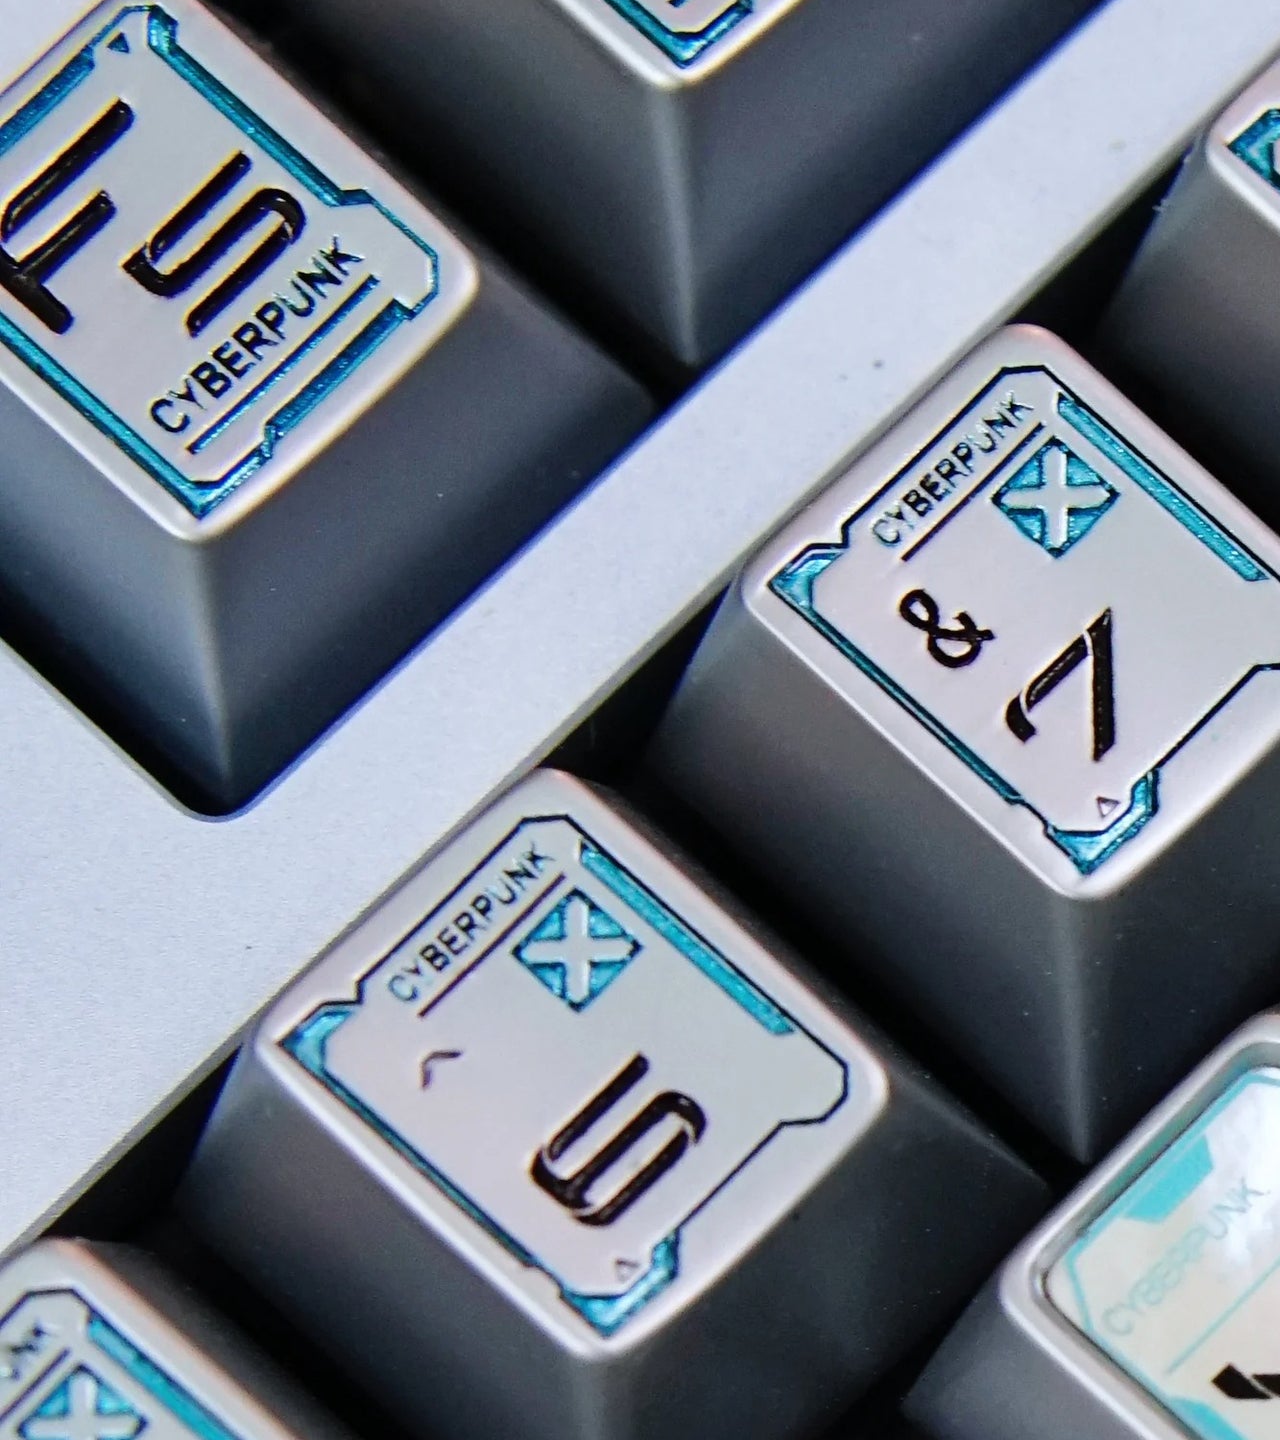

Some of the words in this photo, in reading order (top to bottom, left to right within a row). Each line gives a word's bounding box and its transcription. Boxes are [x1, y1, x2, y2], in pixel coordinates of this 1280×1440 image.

[0, 95, 308, 340] F5
[148, 234, 366, 436] CYBERPUNK
[870, 390, 1035, 550] CYBERPUNK
[897, 586, 996, 670] &
[1004, 605, 1118, 764] 7
[385, 840, 557, 1006] CYBERPUNK
[528, 1051, 708, 1228] 6
